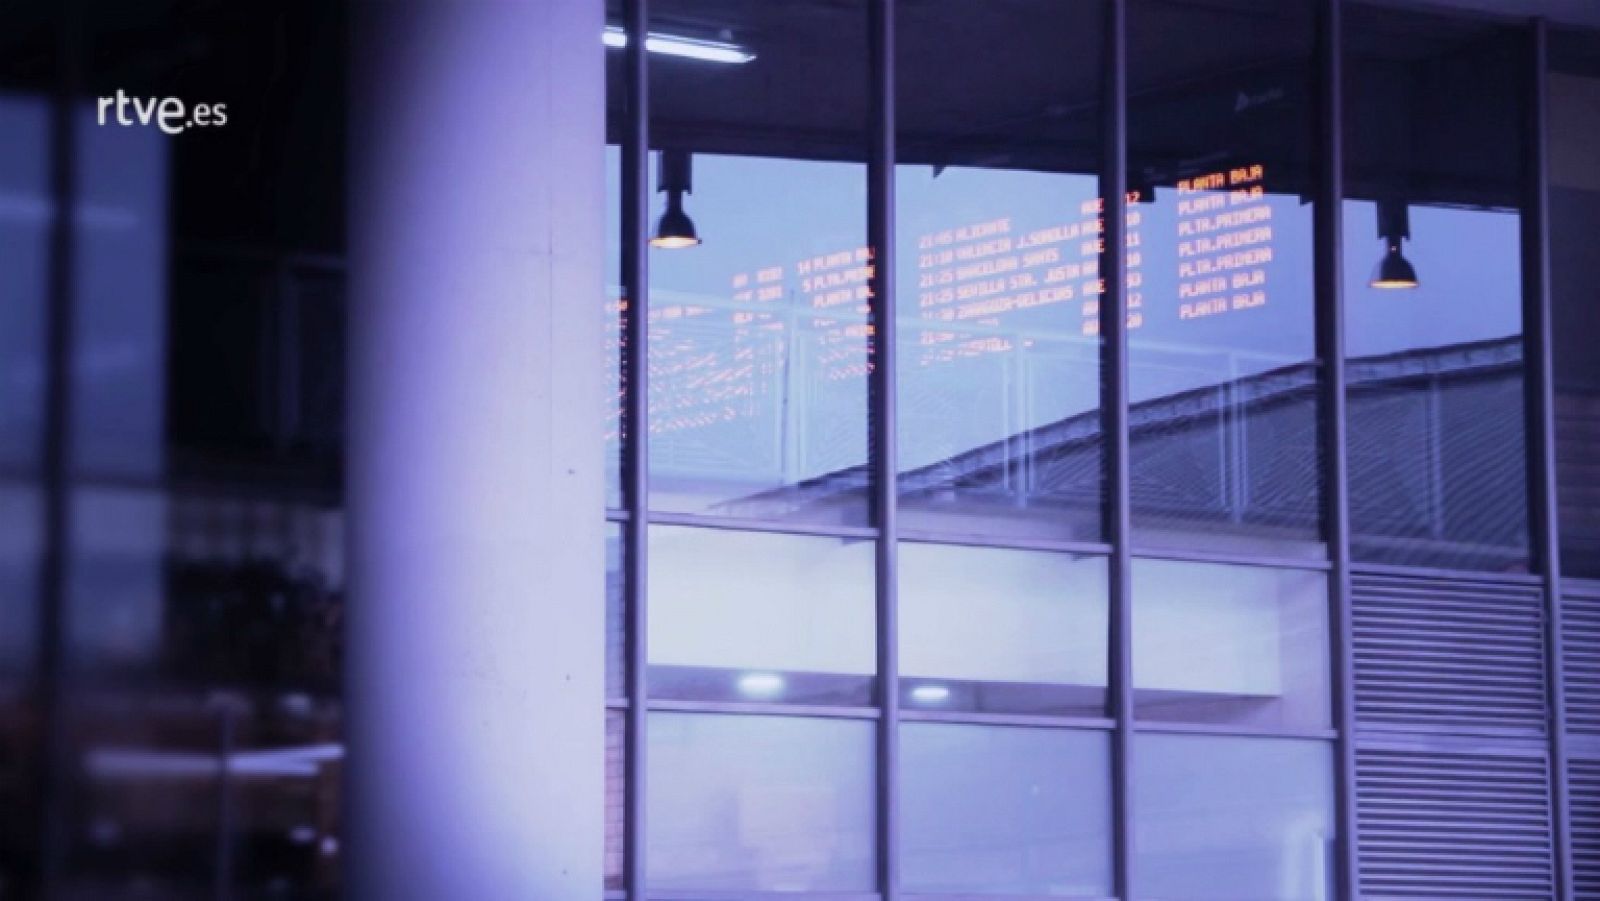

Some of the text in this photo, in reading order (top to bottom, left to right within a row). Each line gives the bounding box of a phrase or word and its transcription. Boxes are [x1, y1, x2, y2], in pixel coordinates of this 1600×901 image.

[1177, 173, 1225, 195] PLANTA
[1230, 164, 1264, 184] BAJA
[955, 236, 1011, 261] VALENCIA
[1177, 195, 1226, 216] PLANTA
[1230, 185, 1264, 205] BAJA
[813, 251, 852, 270] PLANTA
[955, 256, 1018, 280] BARCELONA
[956, 277, 1005, 300] SEVILLA
[1179, 276, 1227, 299] PLANTA
[1232, 269, 1265, 289] BAJA
[1179, 298, 1228, 320] PLANTA
[1232, 290, 1265, 310] BAJA
